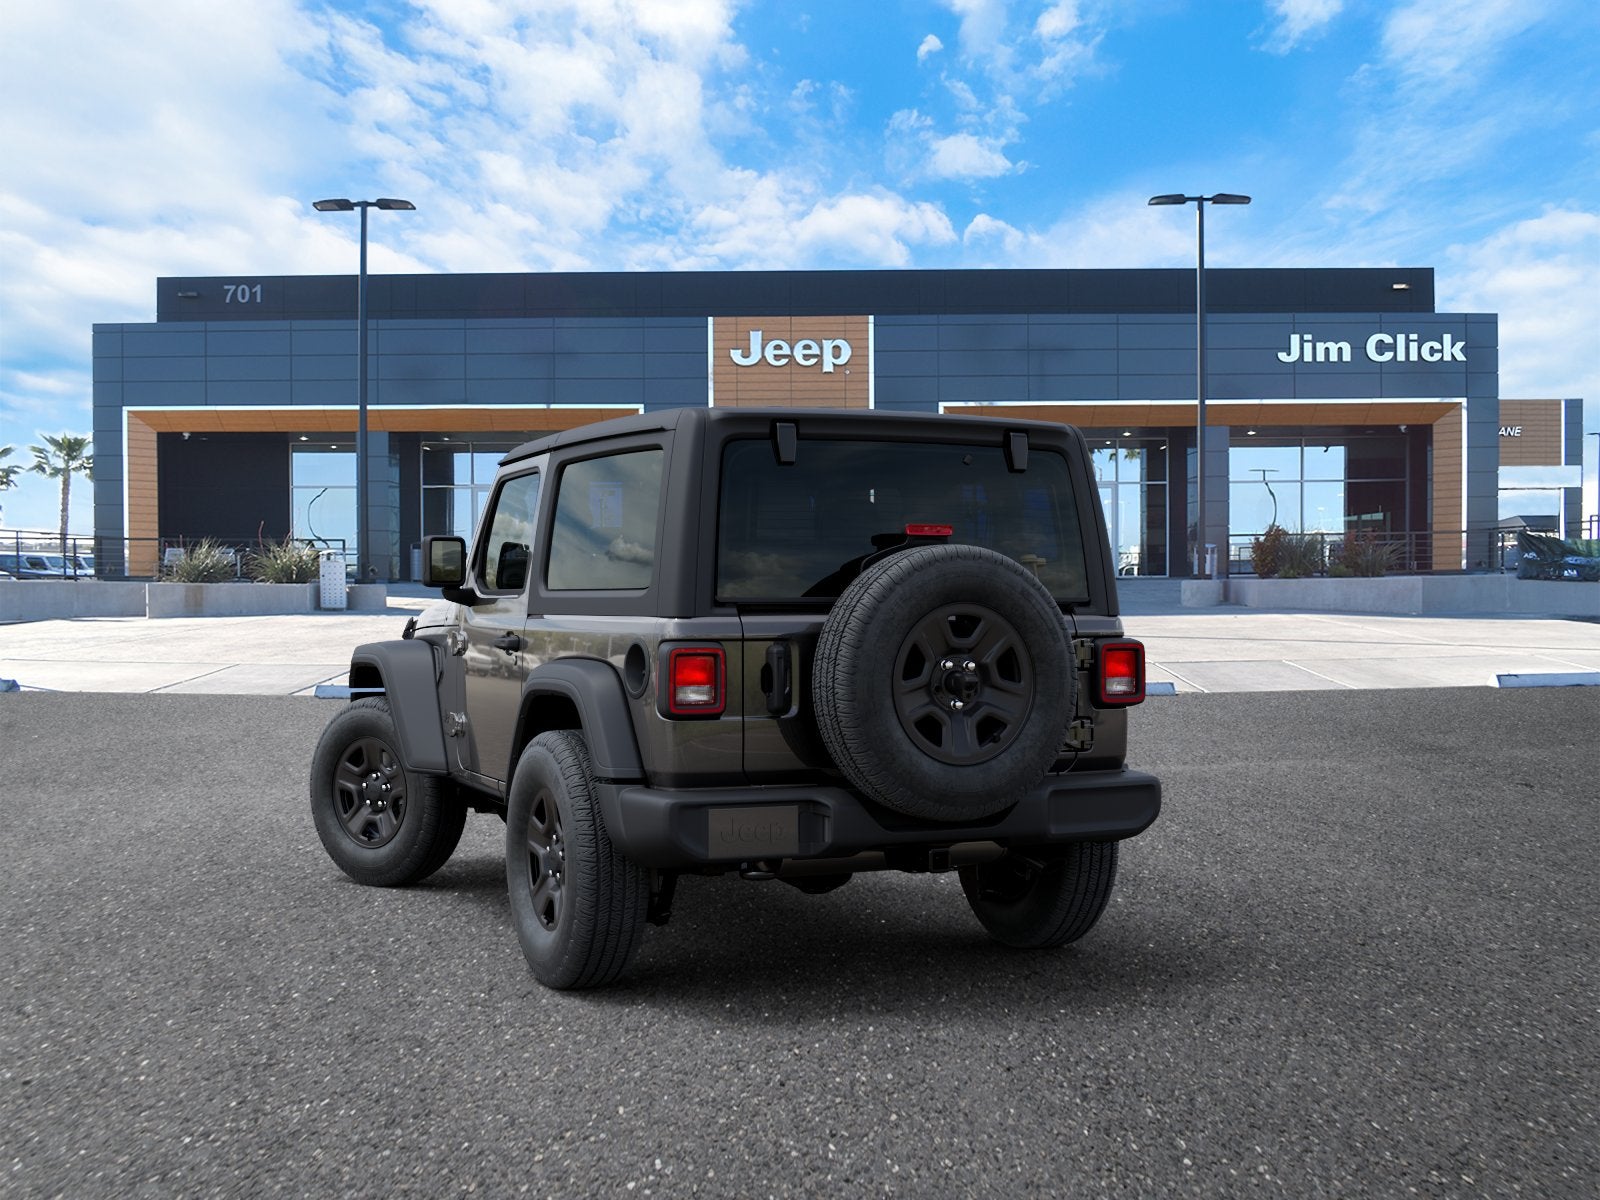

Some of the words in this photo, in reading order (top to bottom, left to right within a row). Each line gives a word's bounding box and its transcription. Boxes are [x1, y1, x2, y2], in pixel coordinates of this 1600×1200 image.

[223, 284, 262, 304] 701
[729, 330, 852, 373] Jeep
[1277, 333, 1352, 363] Jim
[1365, 333, 1467, 362] Click
[720, 815, 785, 848] Jeep
